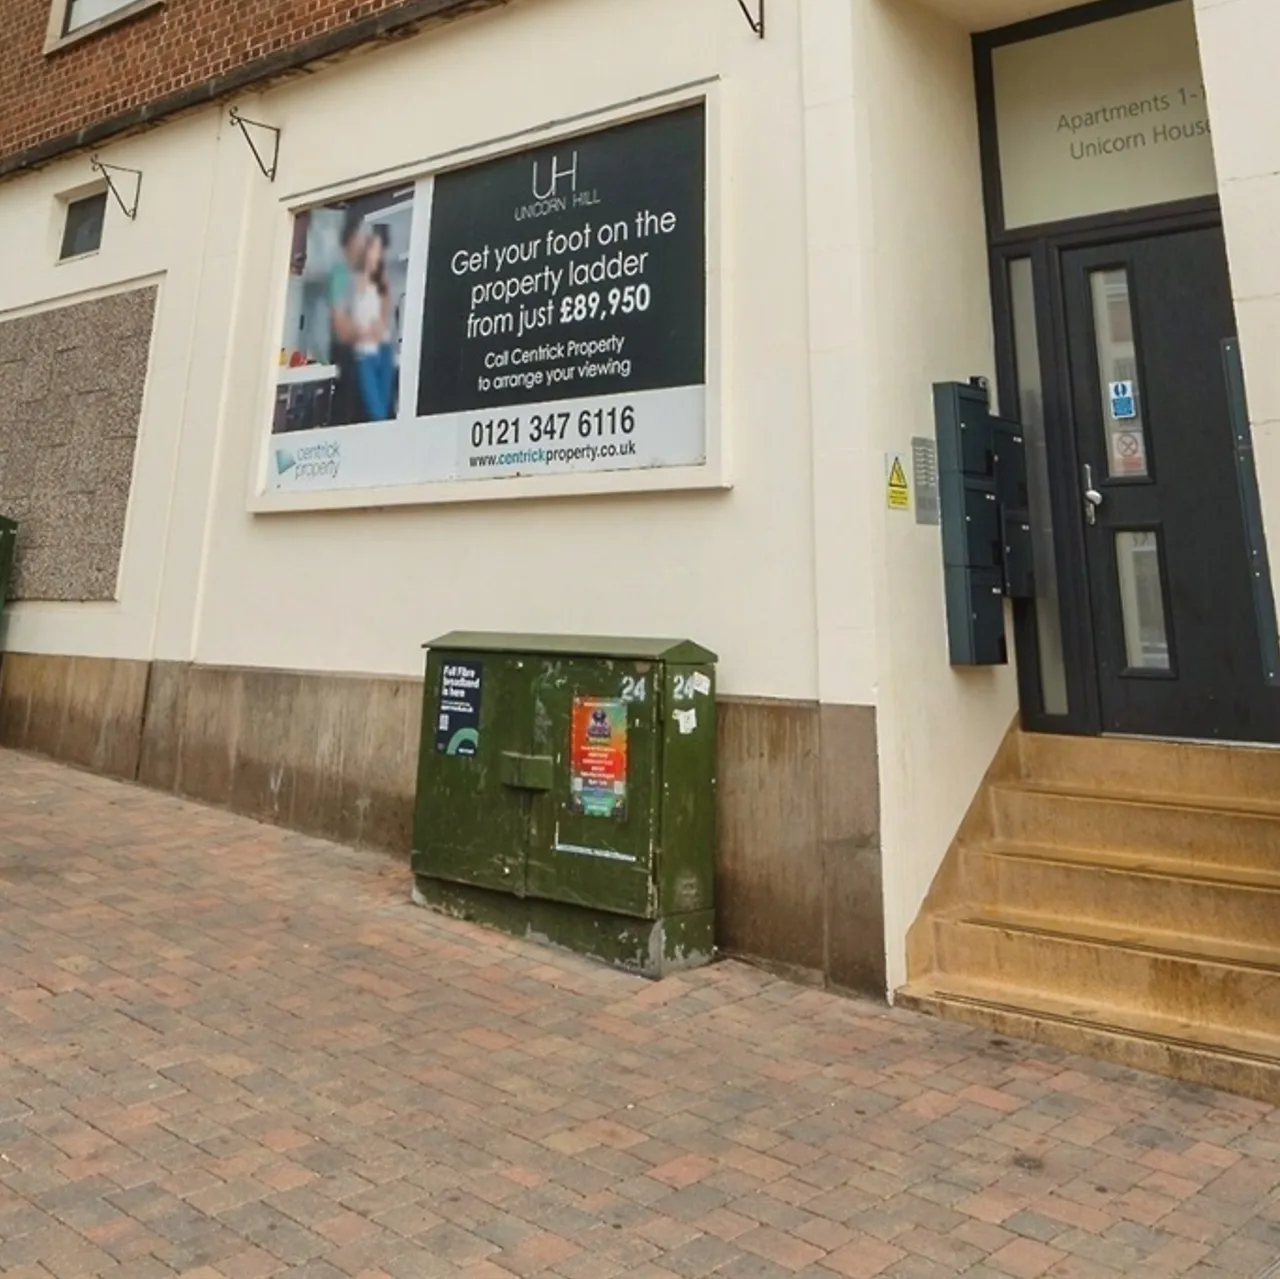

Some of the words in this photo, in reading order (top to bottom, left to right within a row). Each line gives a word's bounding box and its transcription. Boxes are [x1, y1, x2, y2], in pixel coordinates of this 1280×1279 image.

[1056, 95, 1170, 134] Apartments
[1070, 132, 1146, 160] Unicorn
[532, 151, 577, 199] UH
[515, 196, 567, 221] UNICORN
[572, 188, 601, 208] HILL
[451, 245, 490, 275] Get
[494, 238, 541, 272] your
[546, 223, 592, 256] foot
[597, 219, 628, 246] on
[635, 209, 677, 238] the
[471, 265, 564, 310] property
[569, 250, 649, 287] ladder
[467, 312, 513, 338] from
[517, 299, 554, 337] just
[559, 283, 651, 323] £89,950
[484, 350, 509, 370] Call
[511, 342, 565, 366] Centrick
[567, 334, 625, 359] Property
[478, 376, 491, 392] to
[493, 371, 543, 389] arrange
[546, 367, 576, 386] your
[578, 358, 632, 378] viewing
[471, 417, 520, 448] 0121
[529, 411, 570, 443] 347
[578, 405, 635, 438] 6116
[469, 440, 636, 468] www.centrickproperty.co.uk
[622, 675, 646, 702] 24
[673, 674, 695, 700] 24
